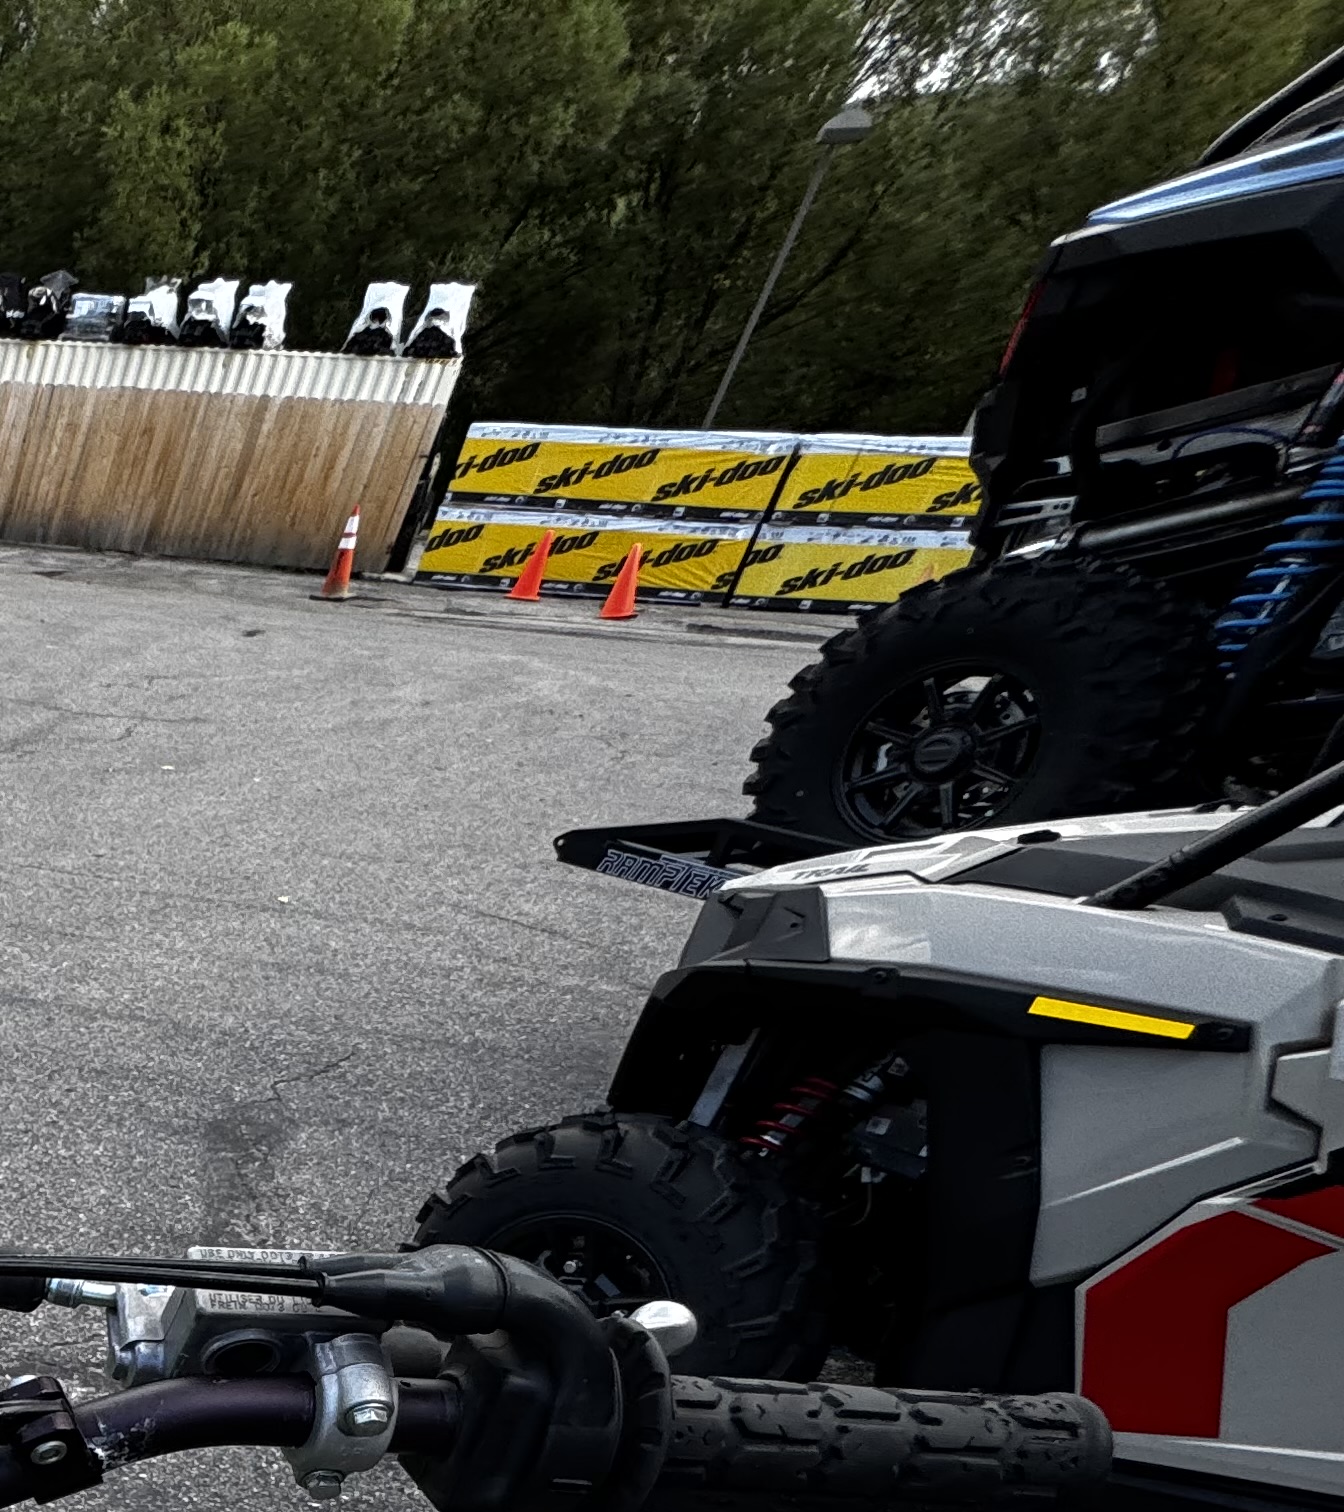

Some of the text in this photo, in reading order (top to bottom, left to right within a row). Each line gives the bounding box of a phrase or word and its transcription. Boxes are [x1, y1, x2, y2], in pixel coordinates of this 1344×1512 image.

[533, 448, 661, 494] ski-doo
[651, 455, 788, 502] ski-doo
[792, 457, 938, 509] ski-doo
[775, 549, 917, 596] ski-doo
